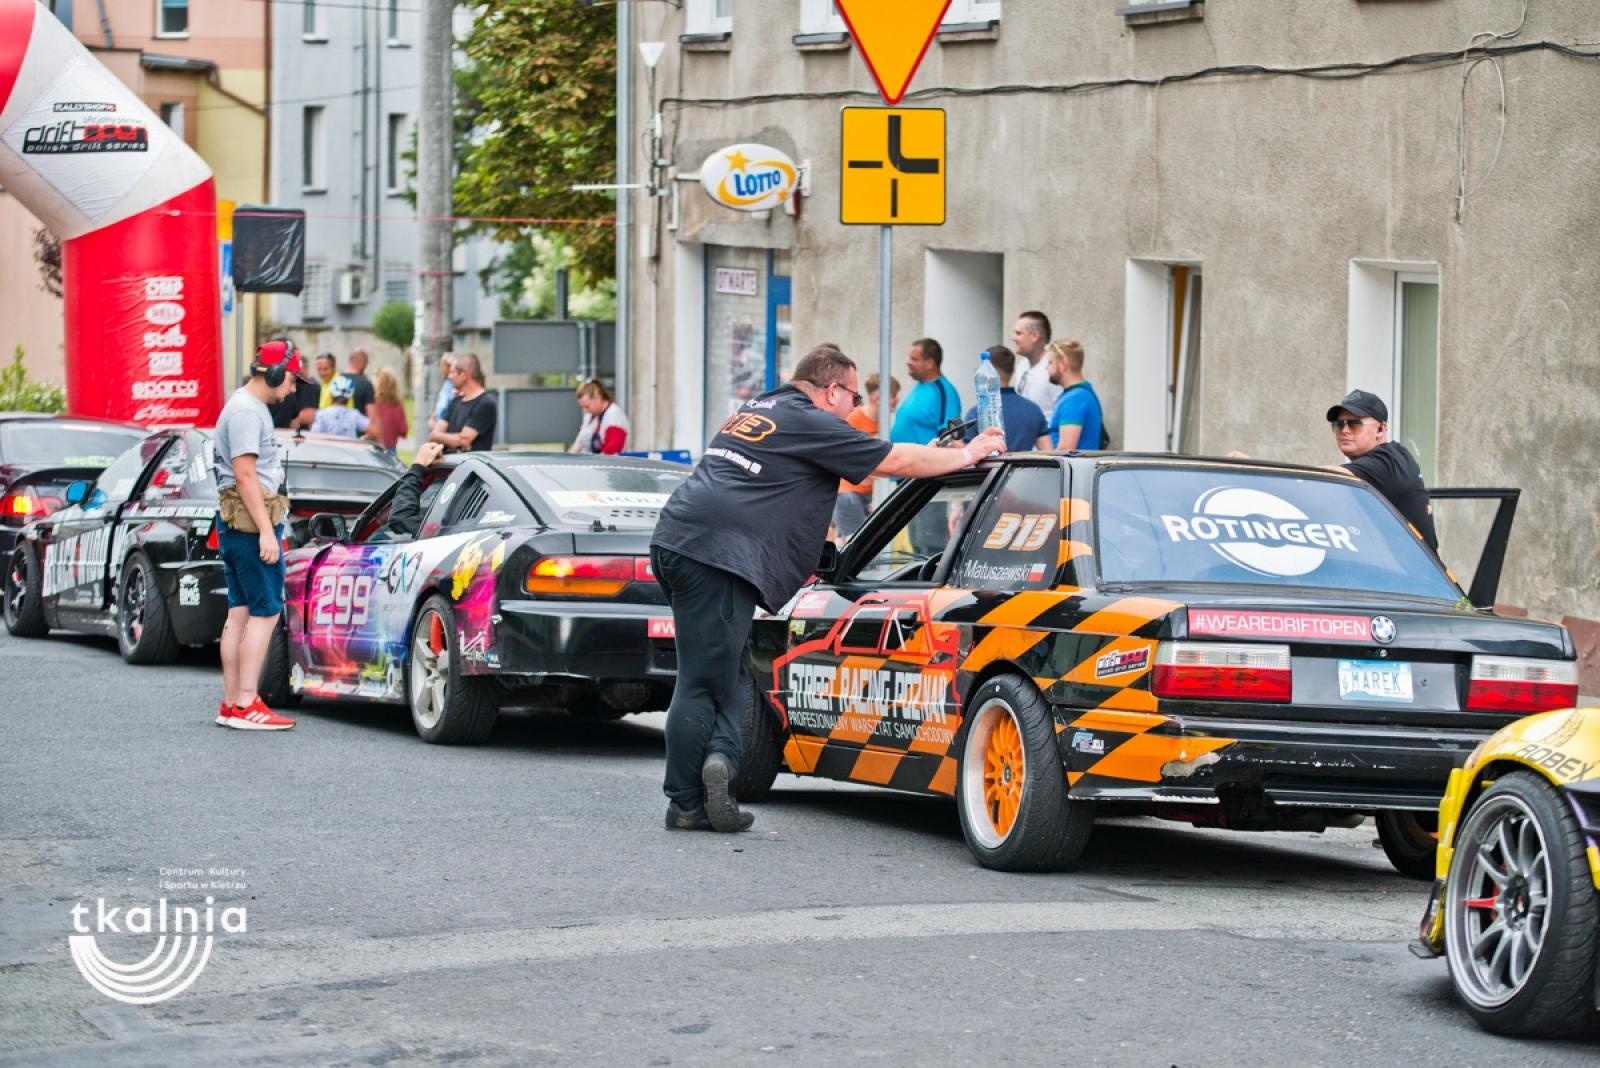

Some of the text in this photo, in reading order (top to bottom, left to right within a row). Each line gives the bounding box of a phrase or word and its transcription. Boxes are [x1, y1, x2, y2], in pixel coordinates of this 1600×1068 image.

[72, 142, 102, 152] drift
[105, 142, 146, 151] series
[734, 170, 781, 196] LOTTO
[132, 381, 198, 399] sparco
[983, 512, 1057, 551] 313
[963, 559, 1032, 581] Matuszewski
[316, 576, 372, 624] 299
[1194, 614, 1367, 637] #WEAREDRIFTOPEN
[788, 663, 836, 712] STREET
[839, 667, 891, 717] RACING
[1351, 671, 1401, 692] MAREK
[850, 719, 893, 737] WARSZTAT
[1512, 743, 1596, 783] ROBEX
